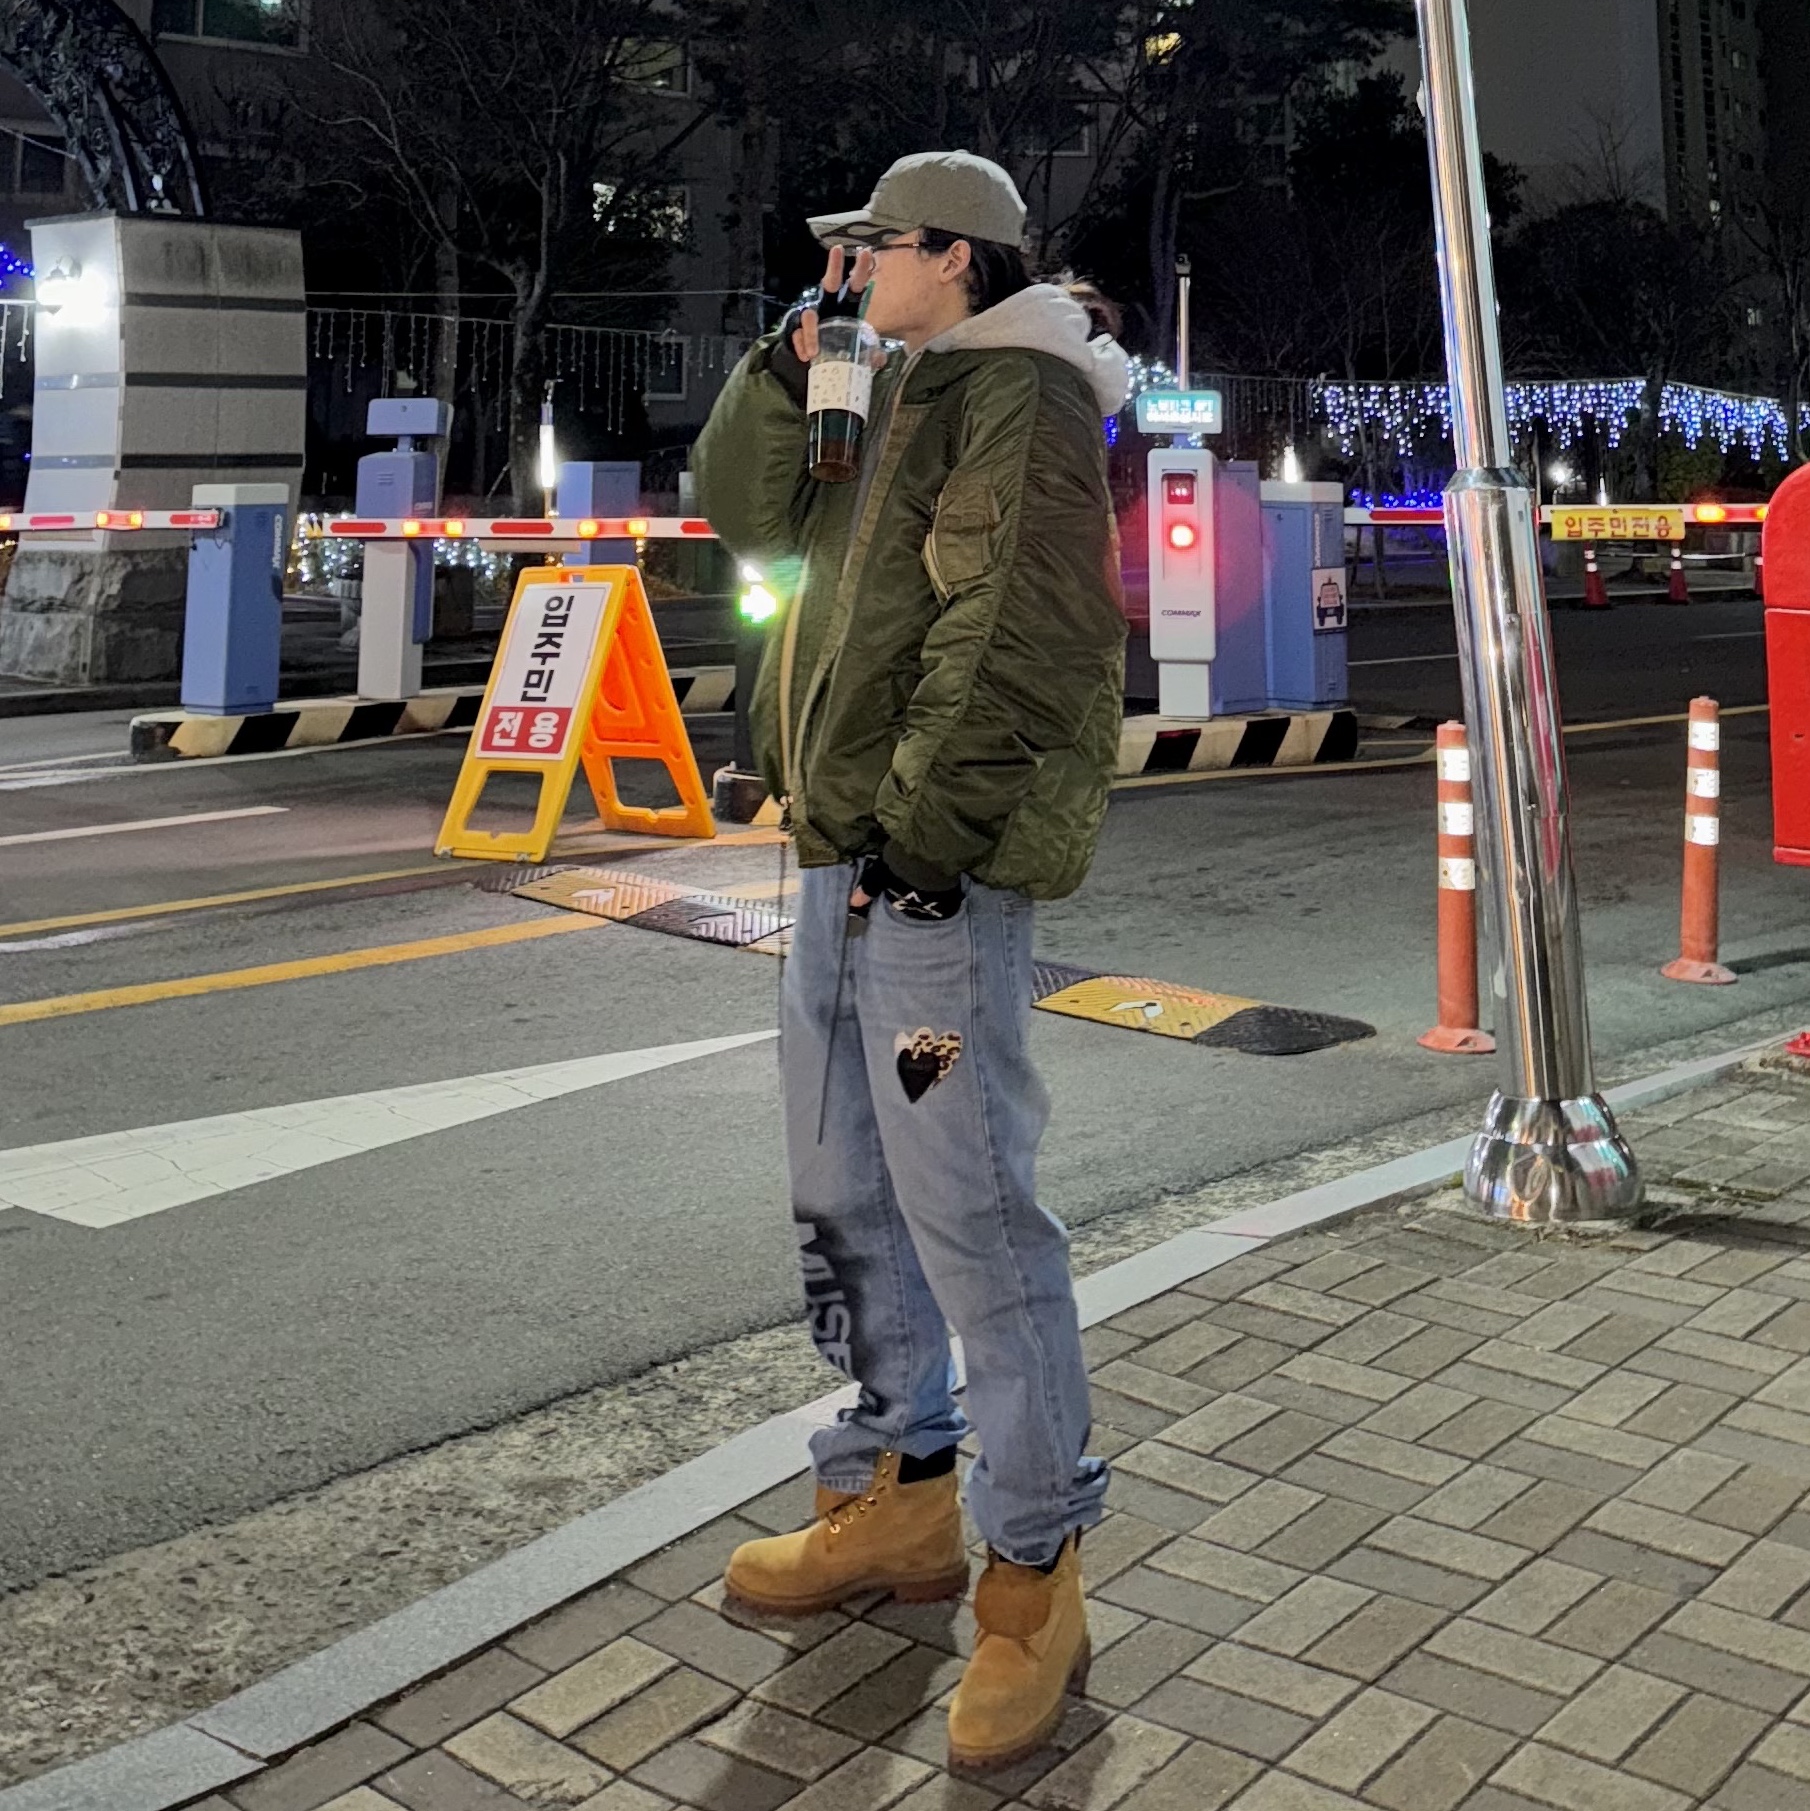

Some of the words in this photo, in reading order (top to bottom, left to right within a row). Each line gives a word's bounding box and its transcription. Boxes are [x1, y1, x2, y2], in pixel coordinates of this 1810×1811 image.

[1564, 515, 1672, 538] 입주민전용
[520, 595, 575, 702] 입주민
[491, 711, 560, 748] 전용
